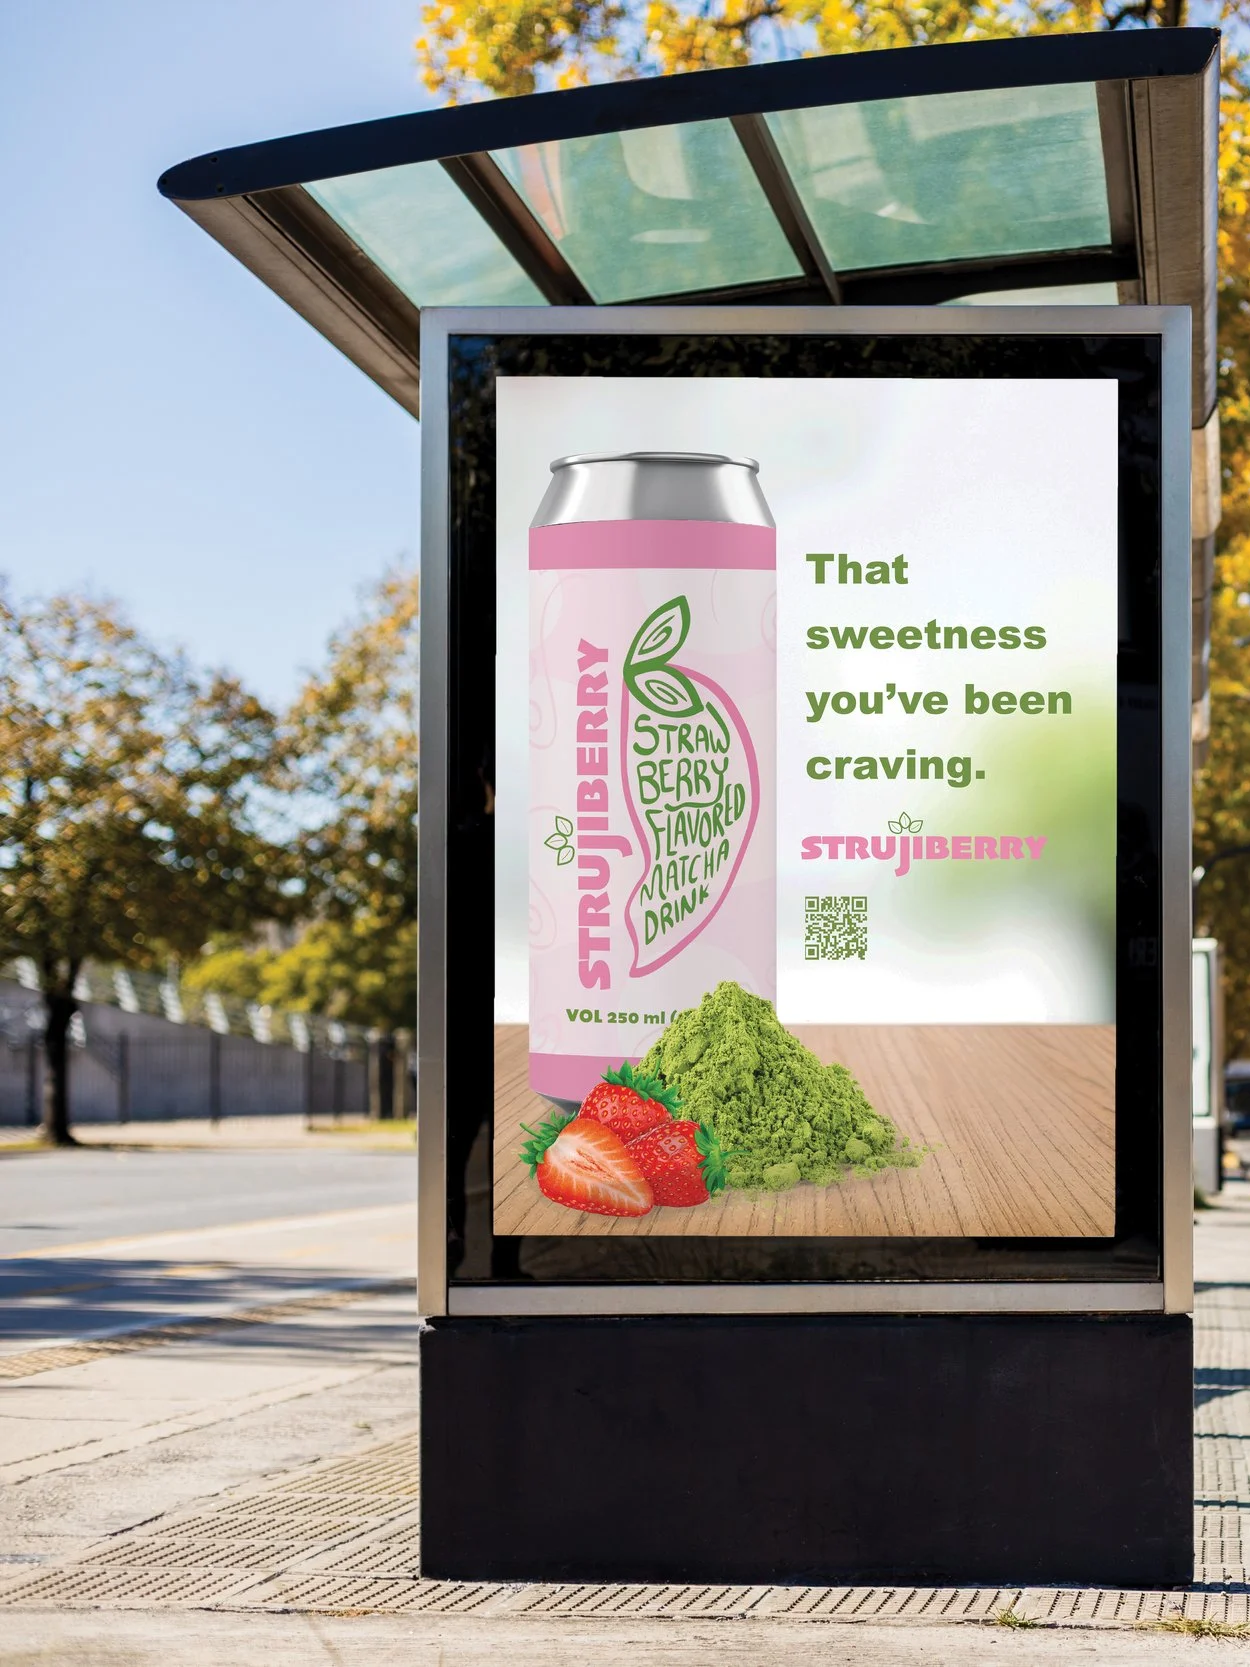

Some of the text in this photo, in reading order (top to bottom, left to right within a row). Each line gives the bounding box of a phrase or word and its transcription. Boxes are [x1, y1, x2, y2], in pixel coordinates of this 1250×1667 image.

[806, 554, 908, 584] That
[806, 618, 1046, 649] sweetness
[966, 684, 1071, 714] been
[632, 701, 731, 755] STRAW
[636, 757, 730, 809] BERRY
[806, 749, 985, 788] craving.
[646, 783, 746, 861] FLAVORED
[640, 838, 730, 907] MATCHA
[644, 883, 710, 946] DRINK
[566, 1008, 603, 1024] VOL
[607, 1012, 640, 1024] 250
[643, 1011, 666, 1025] ml
